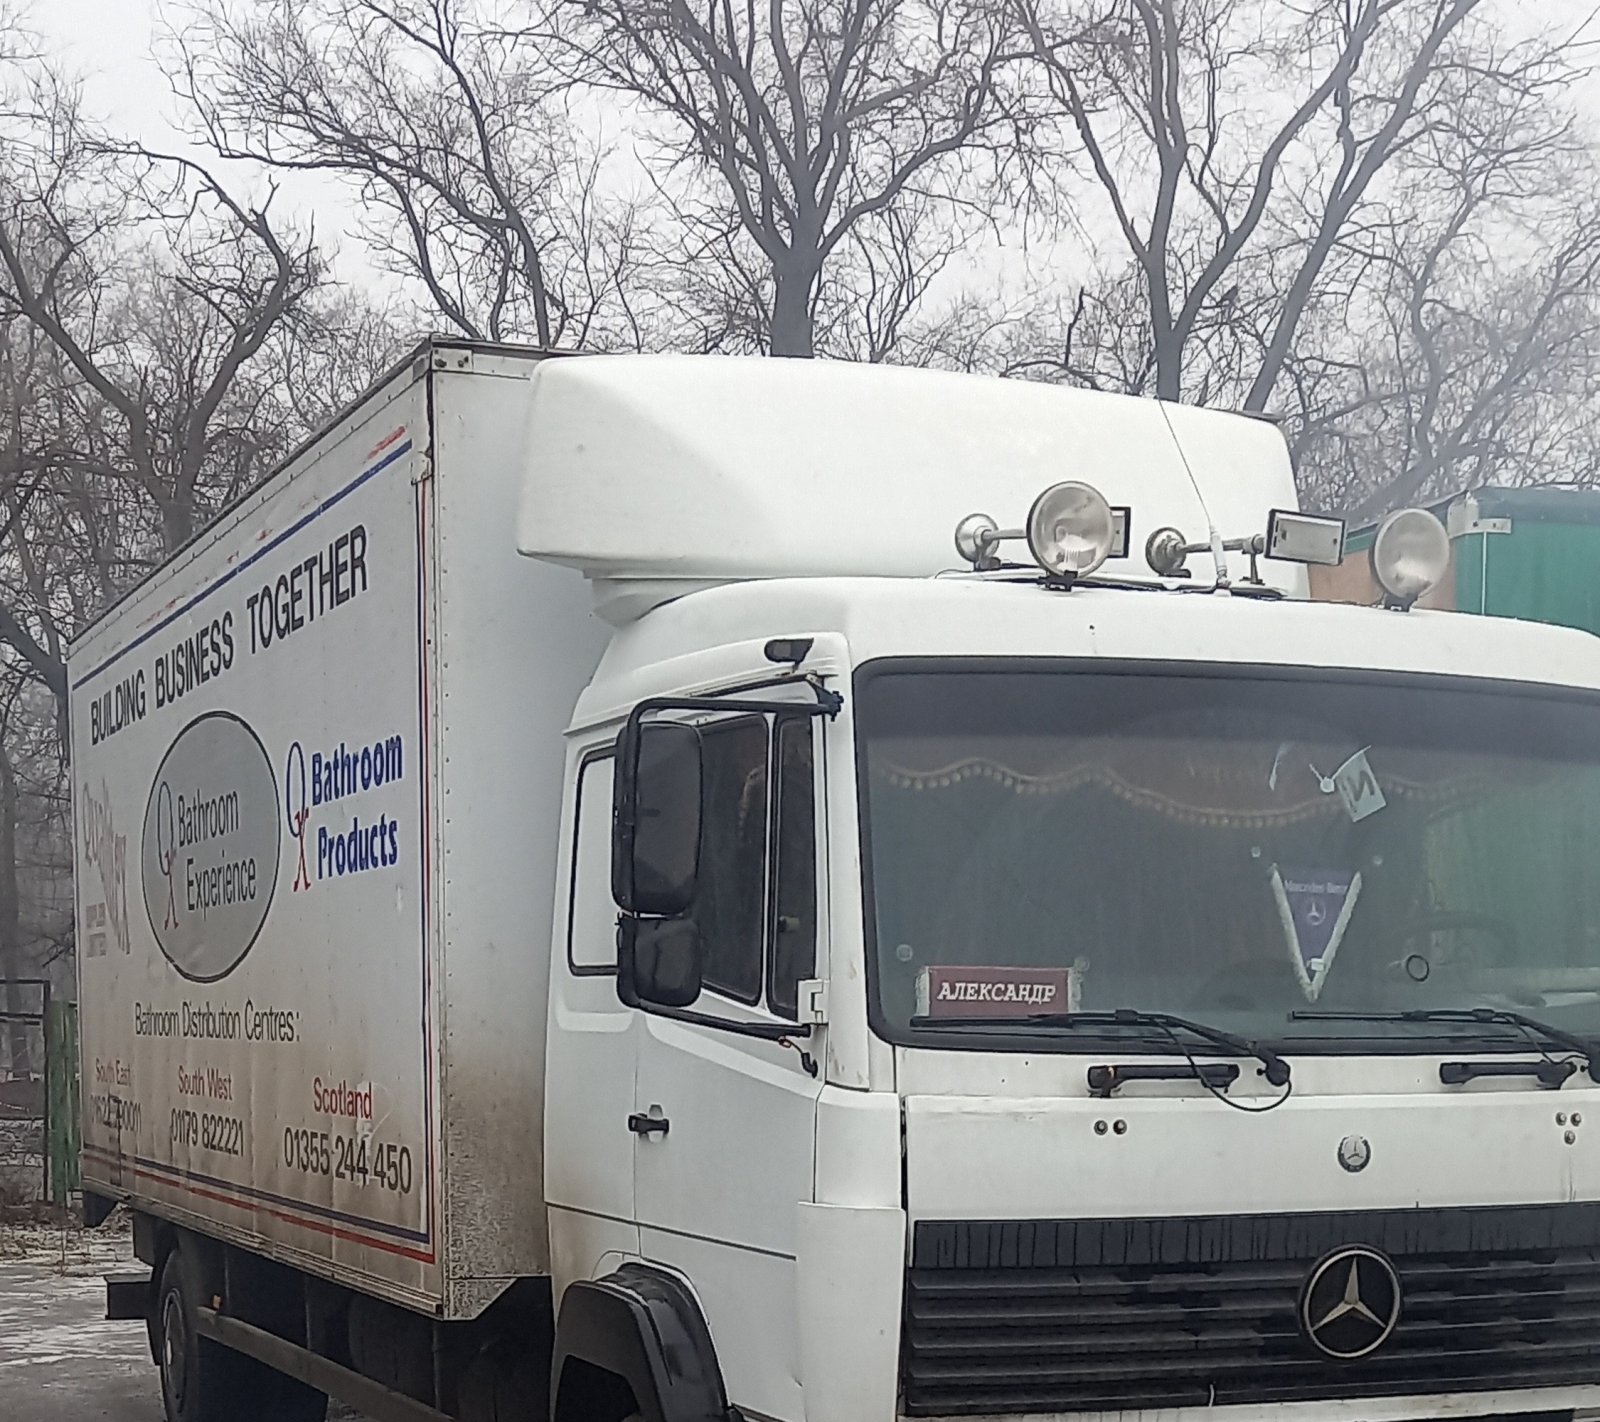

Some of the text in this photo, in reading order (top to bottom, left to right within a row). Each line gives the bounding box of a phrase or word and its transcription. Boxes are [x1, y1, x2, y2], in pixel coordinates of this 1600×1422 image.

[91, 524, 367, 746] BUILDING BUSINESS TOGETHER
[311, 735, 403, 806] Bathroom
[178, 790, 239, 848] Bathroom
[318, 813, 398, 880] Products
[187, 850, 256, 921] Experience
[135, 1002, 180, 1037] Bathroom
[182, 1000, 241, 1040] Distribution
[936, 982, 1056, 1005] АЛЕКСАНДР
[178, 1065, 233, 1101] South West
[313, 1076, 373, 1120] Scotland
[171, 1107, 244, 1157] 01179 822221
[284, 1127, 412, 1195] 01355 244 450
